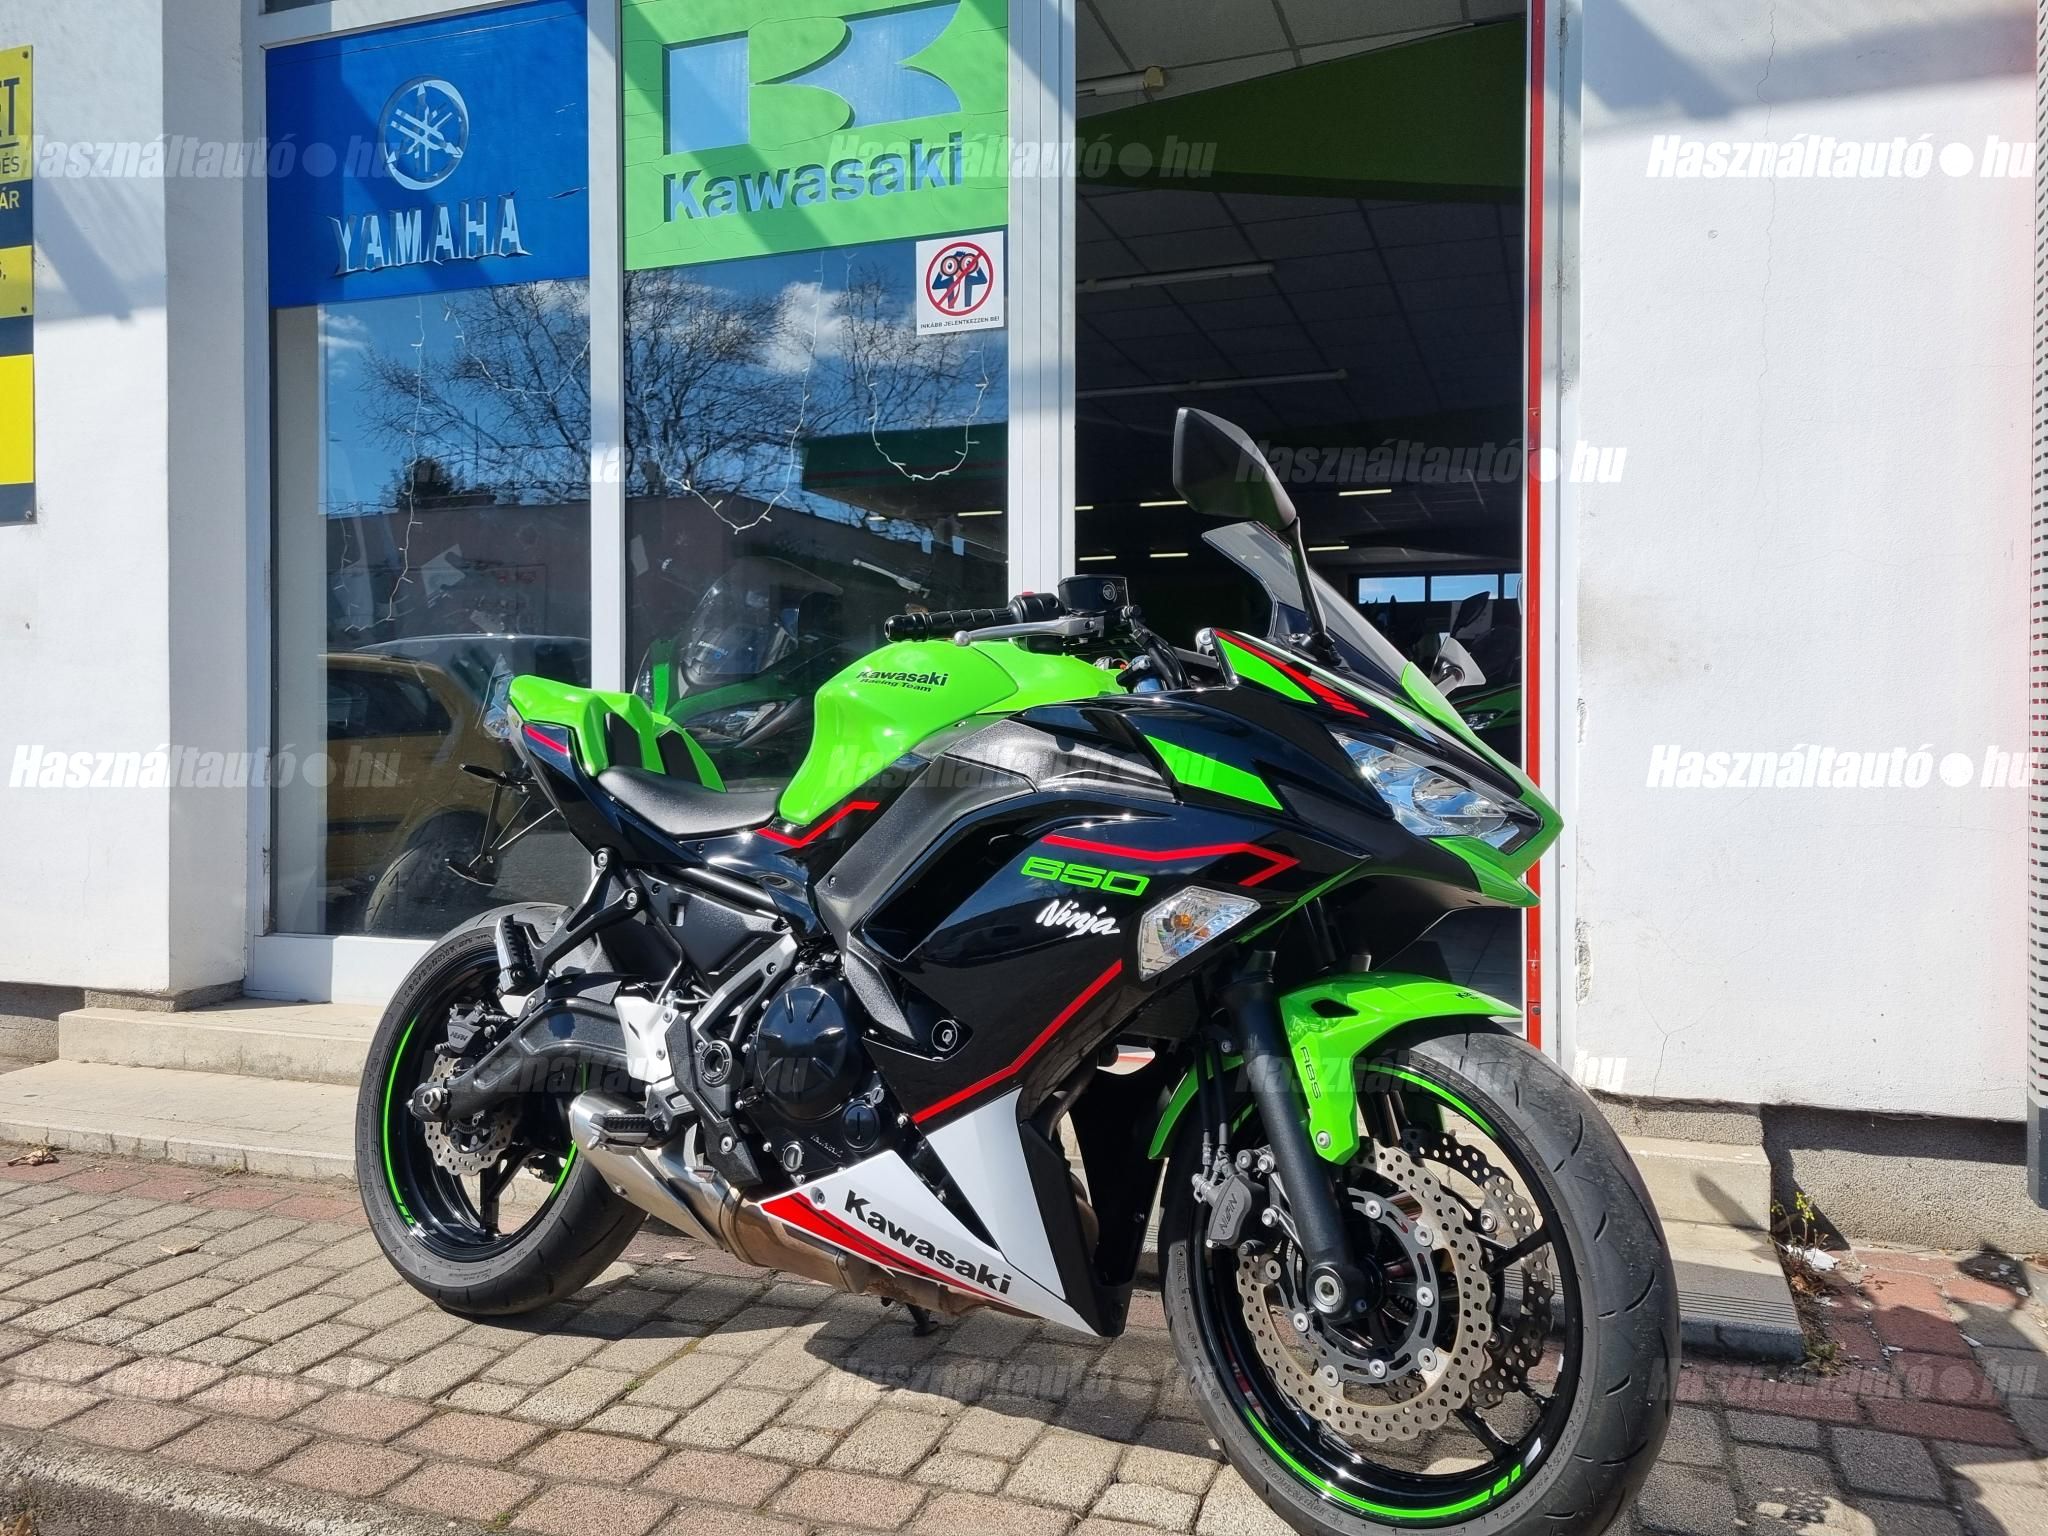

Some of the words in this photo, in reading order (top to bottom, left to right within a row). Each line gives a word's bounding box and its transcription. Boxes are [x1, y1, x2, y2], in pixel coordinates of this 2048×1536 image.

[0, 77, 20, 136] T
[0, 152, 20, 174] ÉS
[664, 132, 963, 222] Kawasaki
[328, 194, 531, 276] YAMAHA
[856, 671, 949, 686] Kawasaki
[859, 679, 898, 687] Racing
[901, 682, 932, 692] Team
[1020, 856, 1150, 897] 650
[1035, 899, 1121, 939] Ninja
[1300, 1046, 1322, 1099] ABS
[844, 1189, 1012, 1295] Kawasaki
